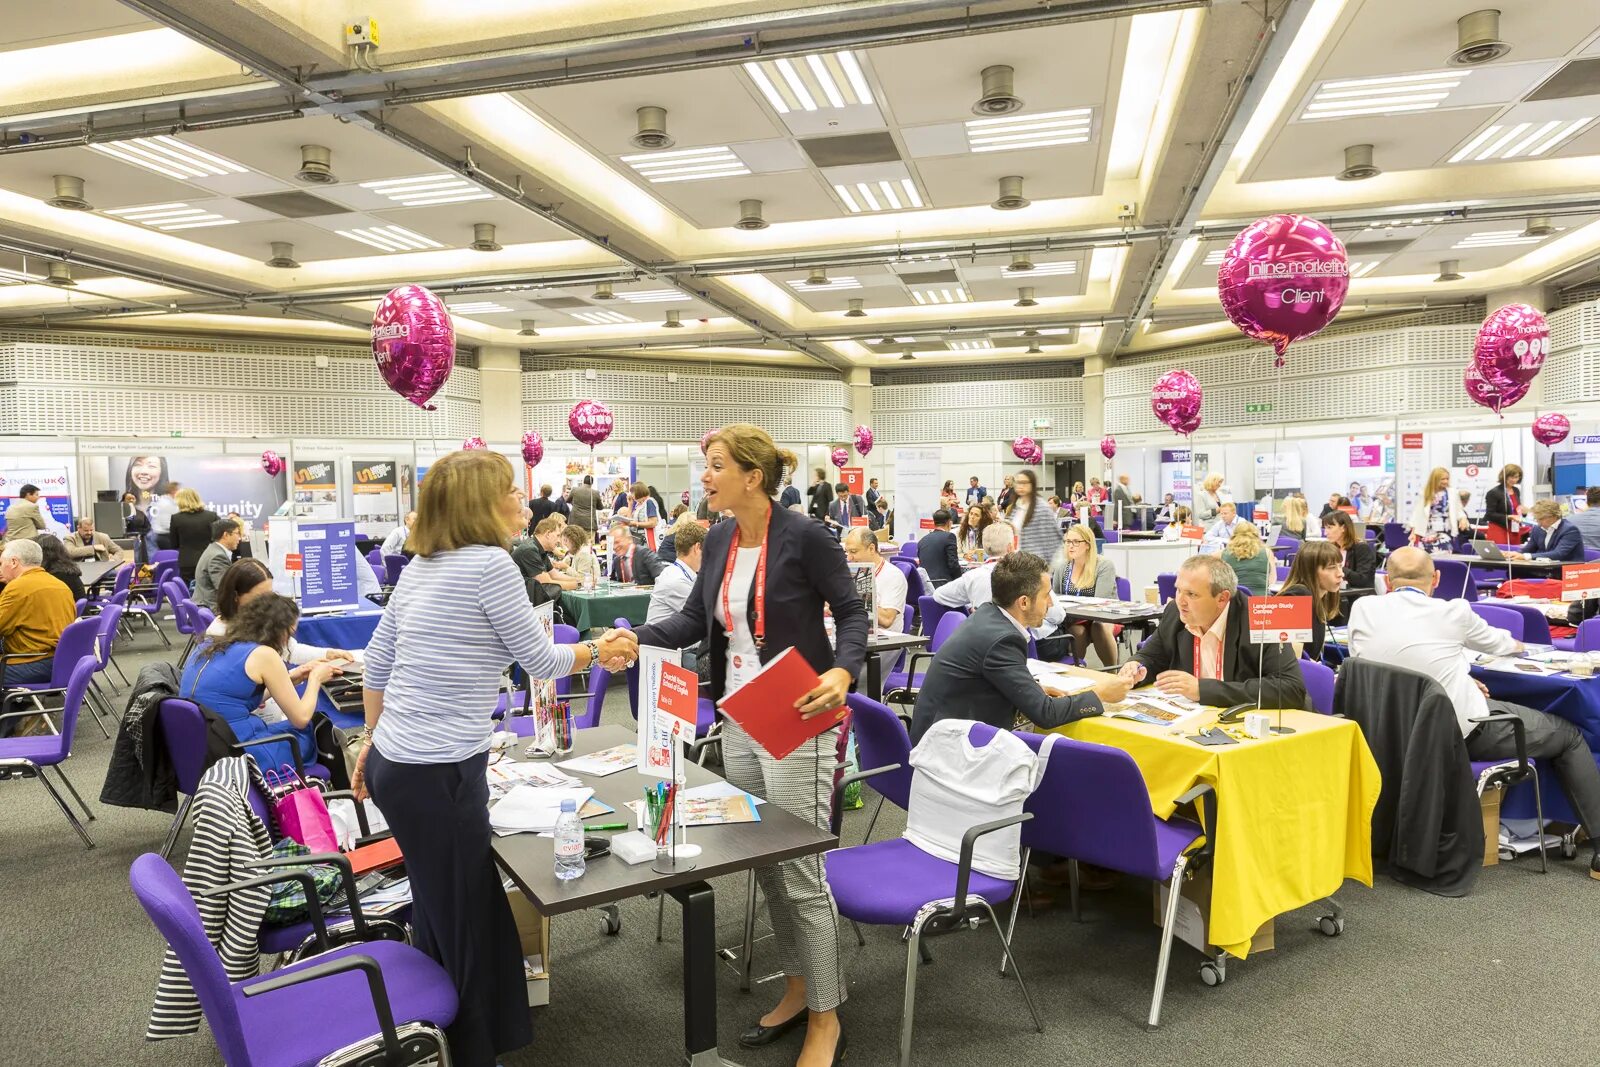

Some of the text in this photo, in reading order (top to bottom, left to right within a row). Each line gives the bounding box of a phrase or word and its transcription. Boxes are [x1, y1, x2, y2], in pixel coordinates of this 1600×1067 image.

[1249, 259, 1349, 276] inline.marketing
[1281, 288, 1325, 304] Client
[1172, 452, 1192, 460] TRINIT
[848, 475, 856, 484] B
[563, 843, 581, 851] evian
